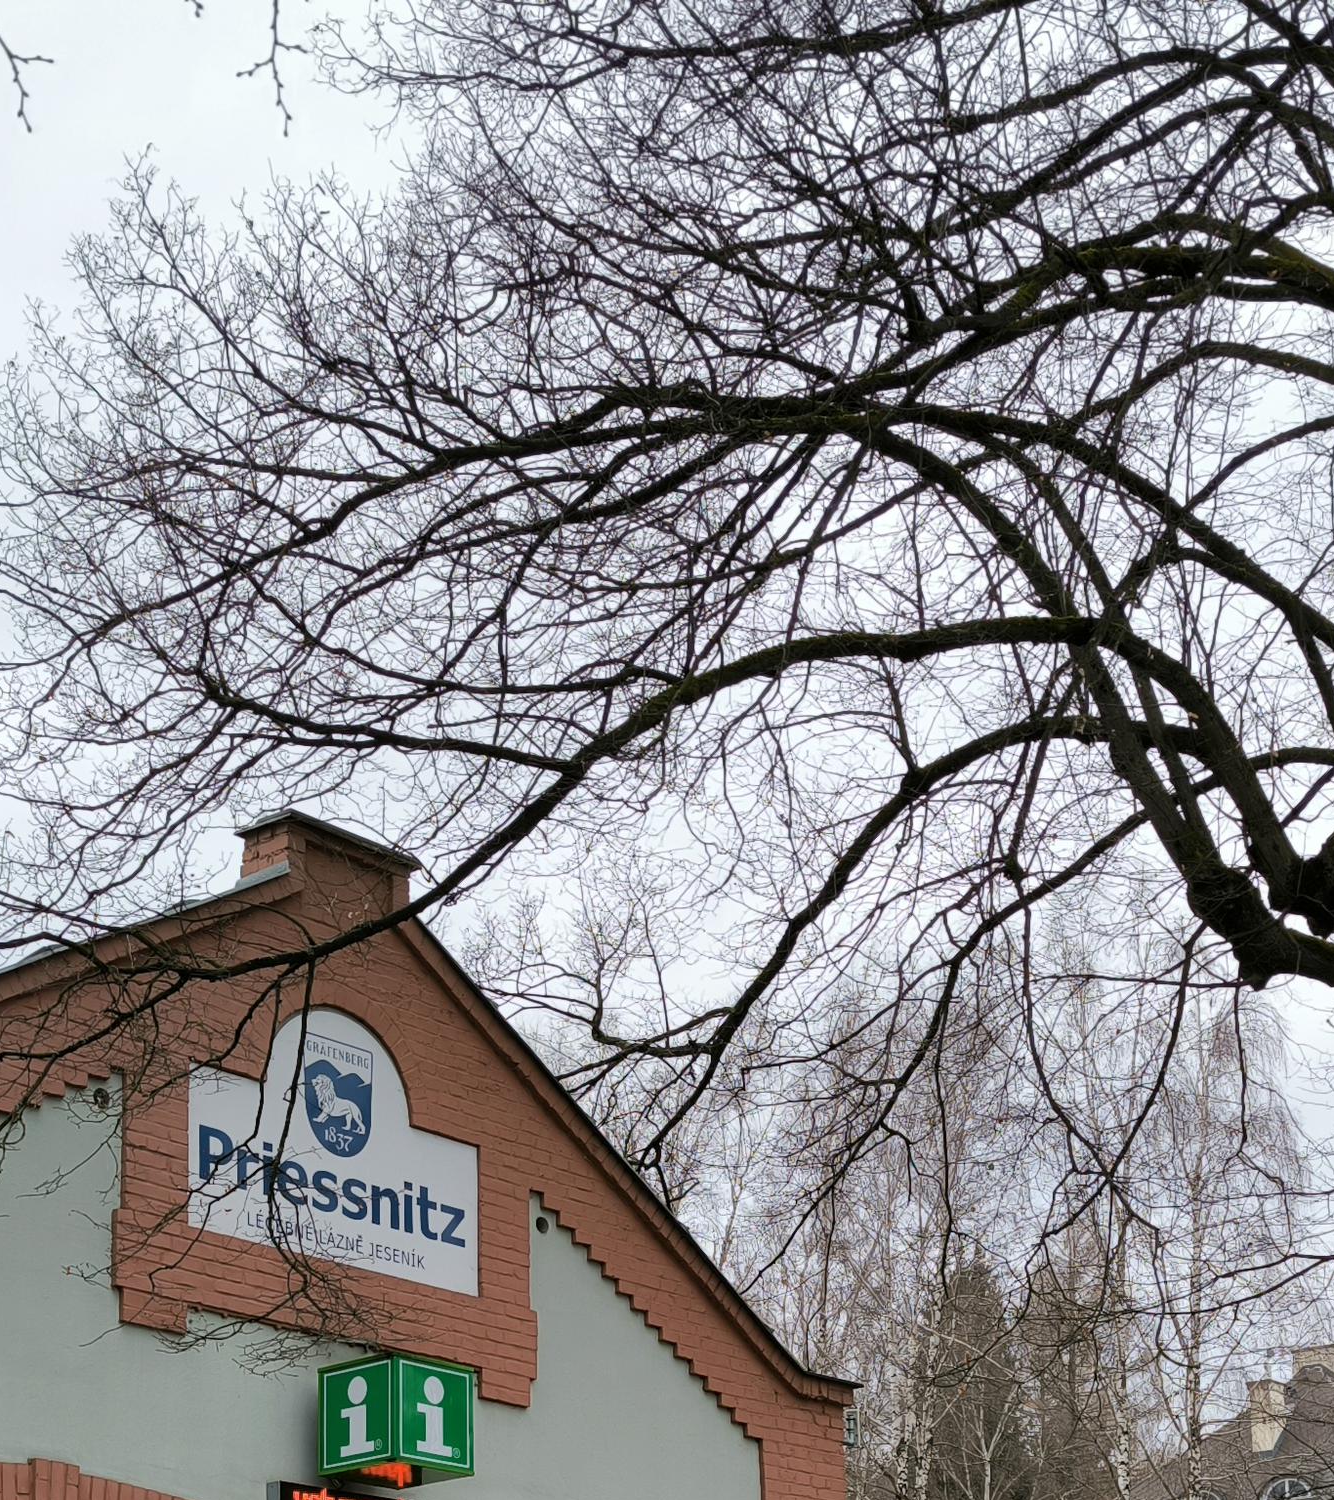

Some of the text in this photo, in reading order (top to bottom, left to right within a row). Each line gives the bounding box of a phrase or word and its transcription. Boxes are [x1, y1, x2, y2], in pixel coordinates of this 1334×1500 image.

[324, 1126, 354, 1152] 1837
[198, 1123, 466, 1248] Priessnitz
[369, 1241, 426, 1270] JESENÍK
